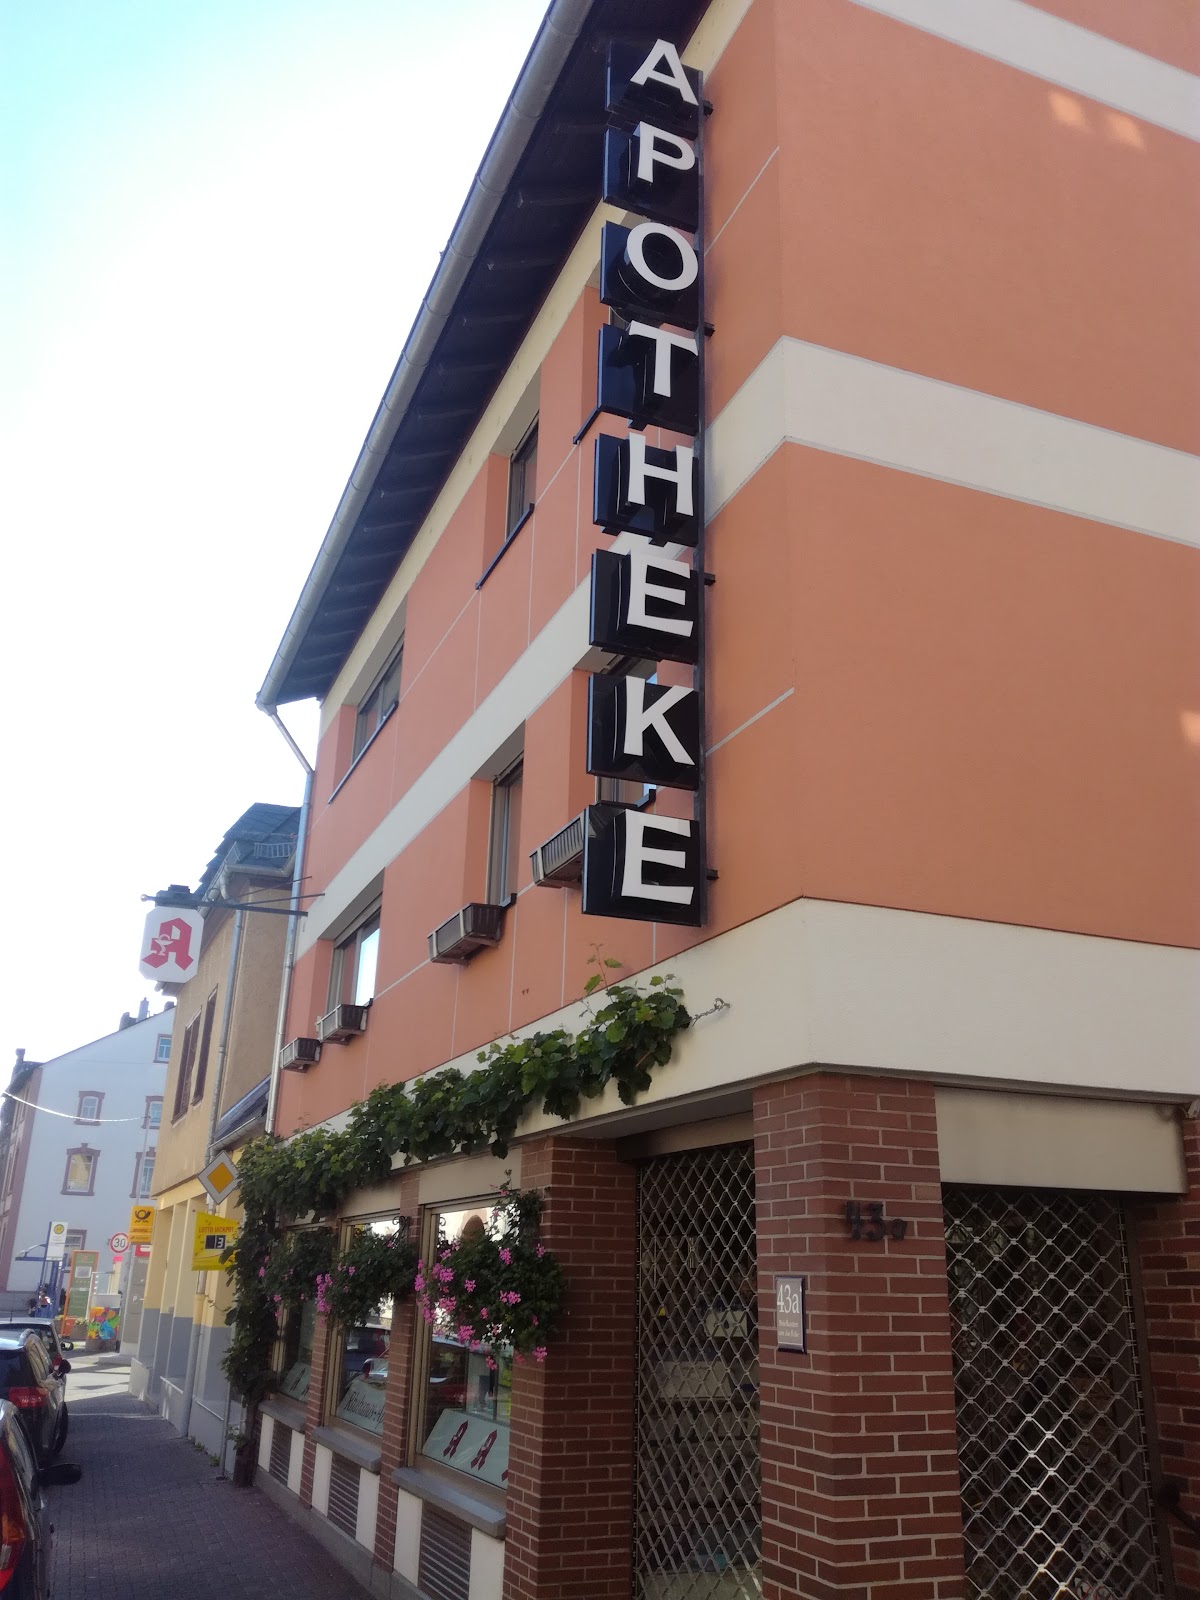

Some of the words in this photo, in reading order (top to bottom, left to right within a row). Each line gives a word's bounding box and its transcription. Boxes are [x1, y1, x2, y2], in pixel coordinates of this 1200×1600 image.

[621, 39, 698, 905] APOTHEKE
[113, 1237, 126, 1249] 30
[777, 1284, 800, 1314] 43a
